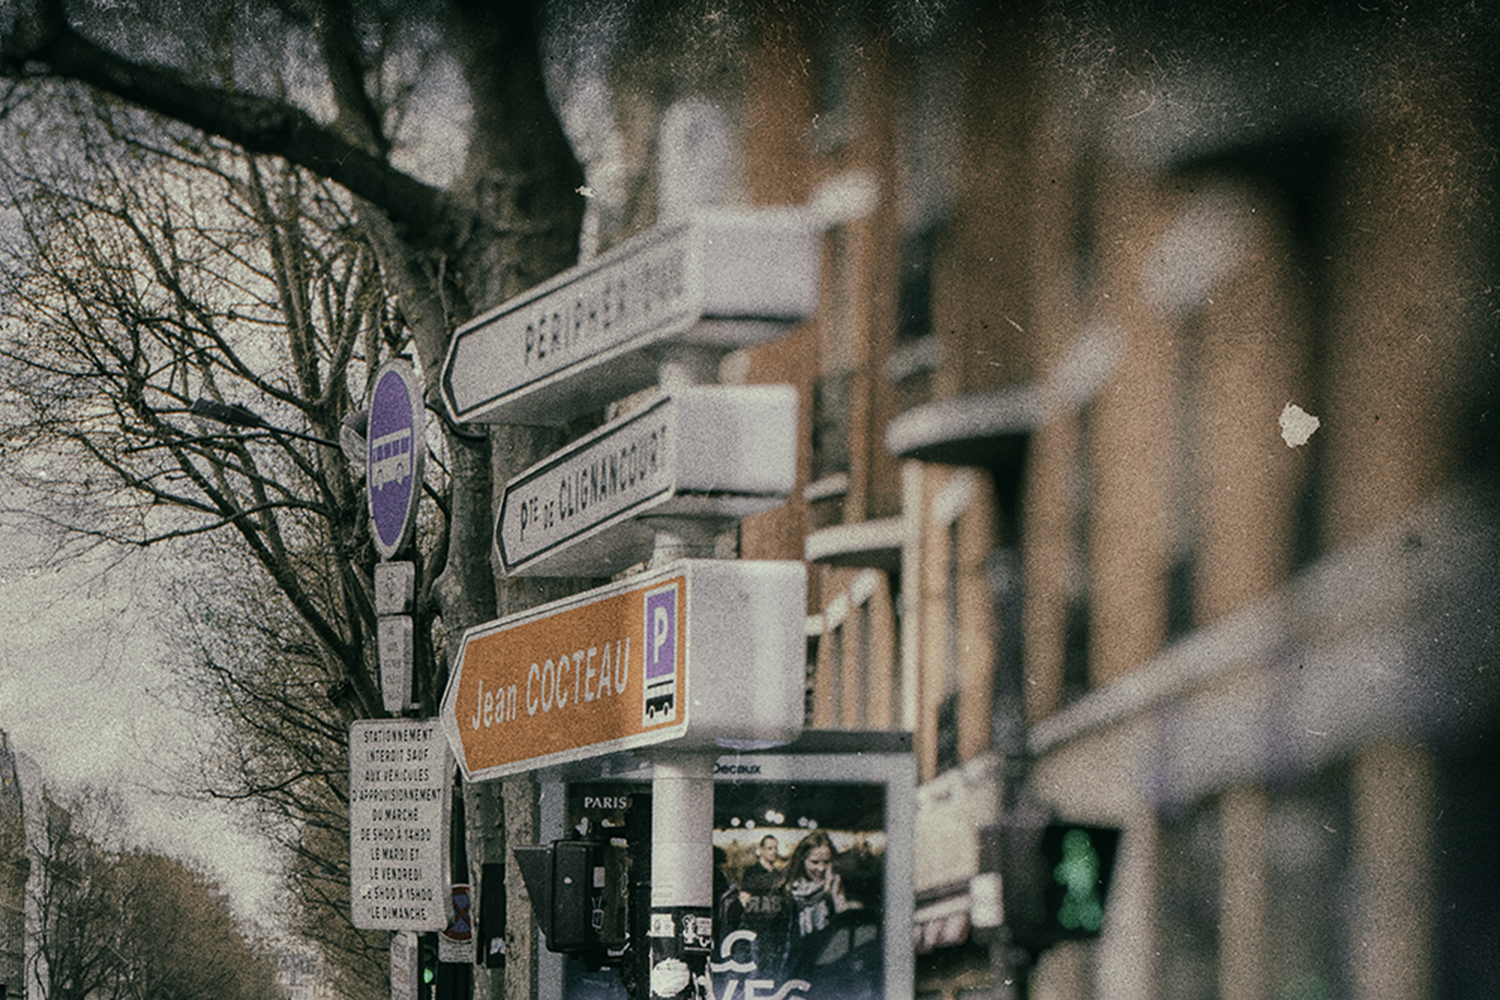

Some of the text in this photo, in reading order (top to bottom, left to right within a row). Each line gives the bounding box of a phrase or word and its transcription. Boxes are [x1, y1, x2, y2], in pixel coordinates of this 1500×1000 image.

[559, 424, 667, 521] CLIGNANCOURT
[471, 637, 630, 730] Jean COCTEAU
[363, 728, 433, 743] STATIONNEMENT
[366, 748, 429, 762] INTERDIT SAUF
[364, 769, 381, 782] AUX
[584, 796, 627, 809] PARIS
[372, 808, 382, 821] DU
[360, 828, 370, 841] DE
[370, 847, 420, 861] LE MARDI ET
[369, 866, 423, 881] LE VENDREDI
[370, 905, 427, 921] LE DIMANCHE
